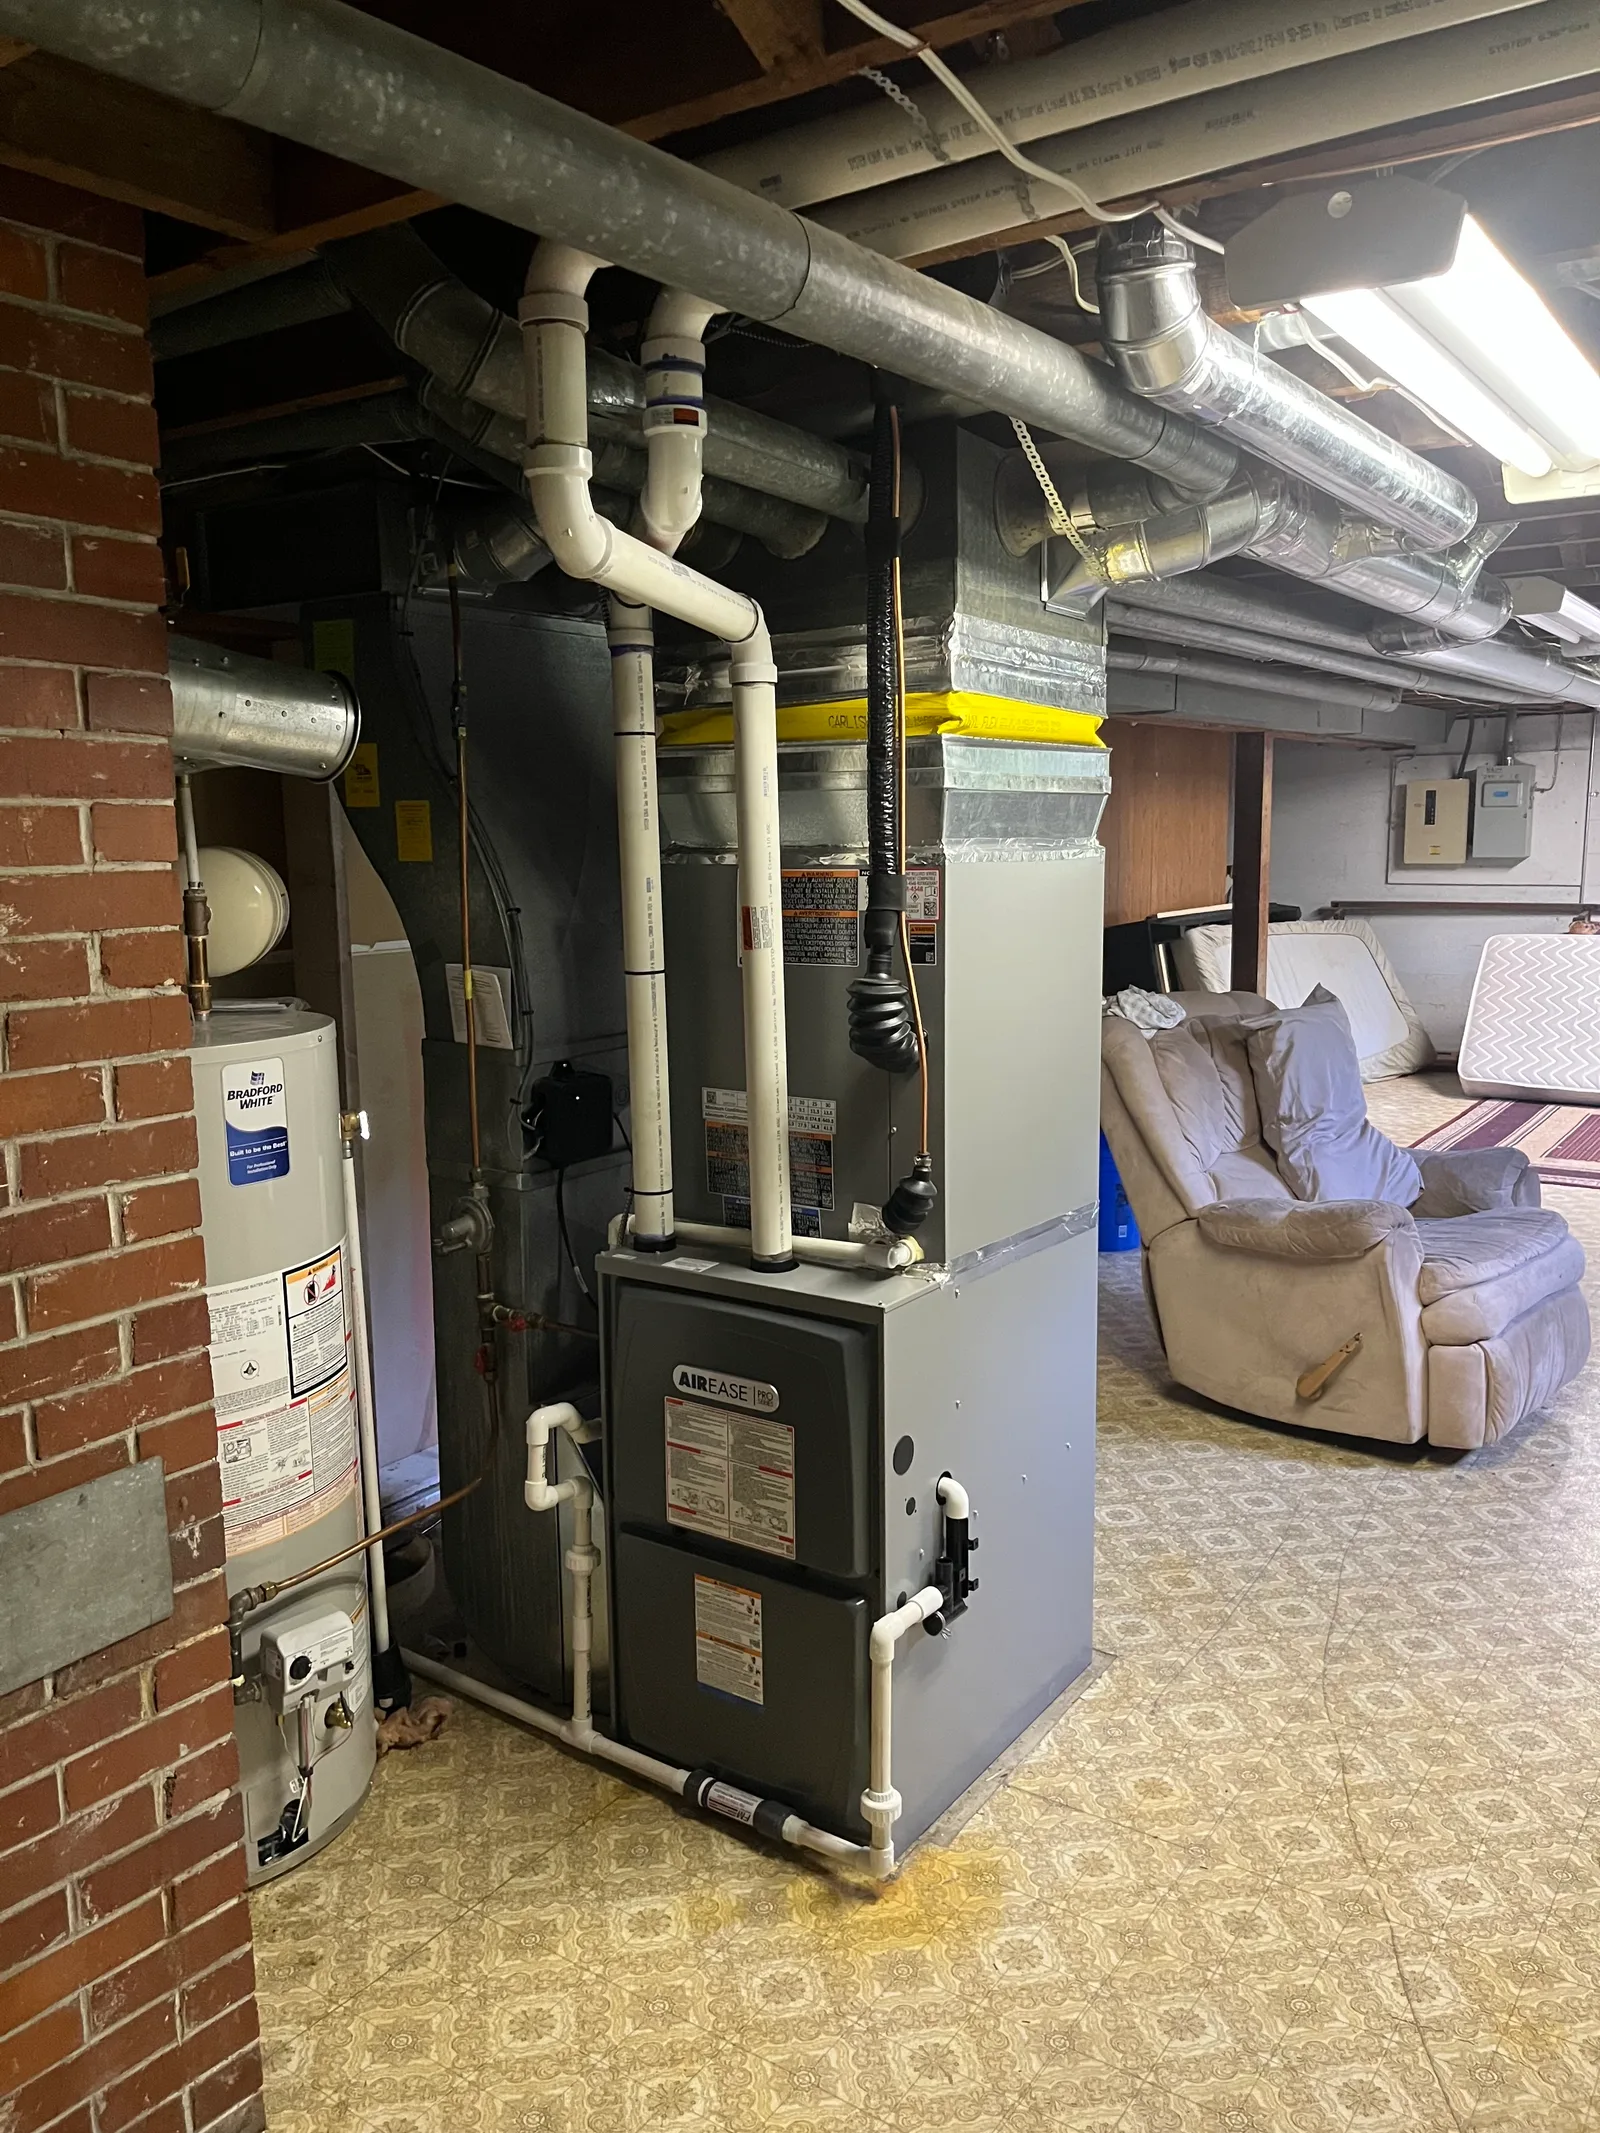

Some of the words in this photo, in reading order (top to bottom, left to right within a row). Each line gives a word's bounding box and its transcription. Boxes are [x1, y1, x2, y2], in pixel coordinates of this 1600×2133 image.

[227, 1083, 283, 1101] BRADFORD
[239, 1096, 273, 1110] WHITE
[230, 1149, 243, 1157] Built
[262, 1143, 272, 1151] the
[679, 1371, 748, 1402] AIREASE
[757, 1389, 774, 1402] PRO
